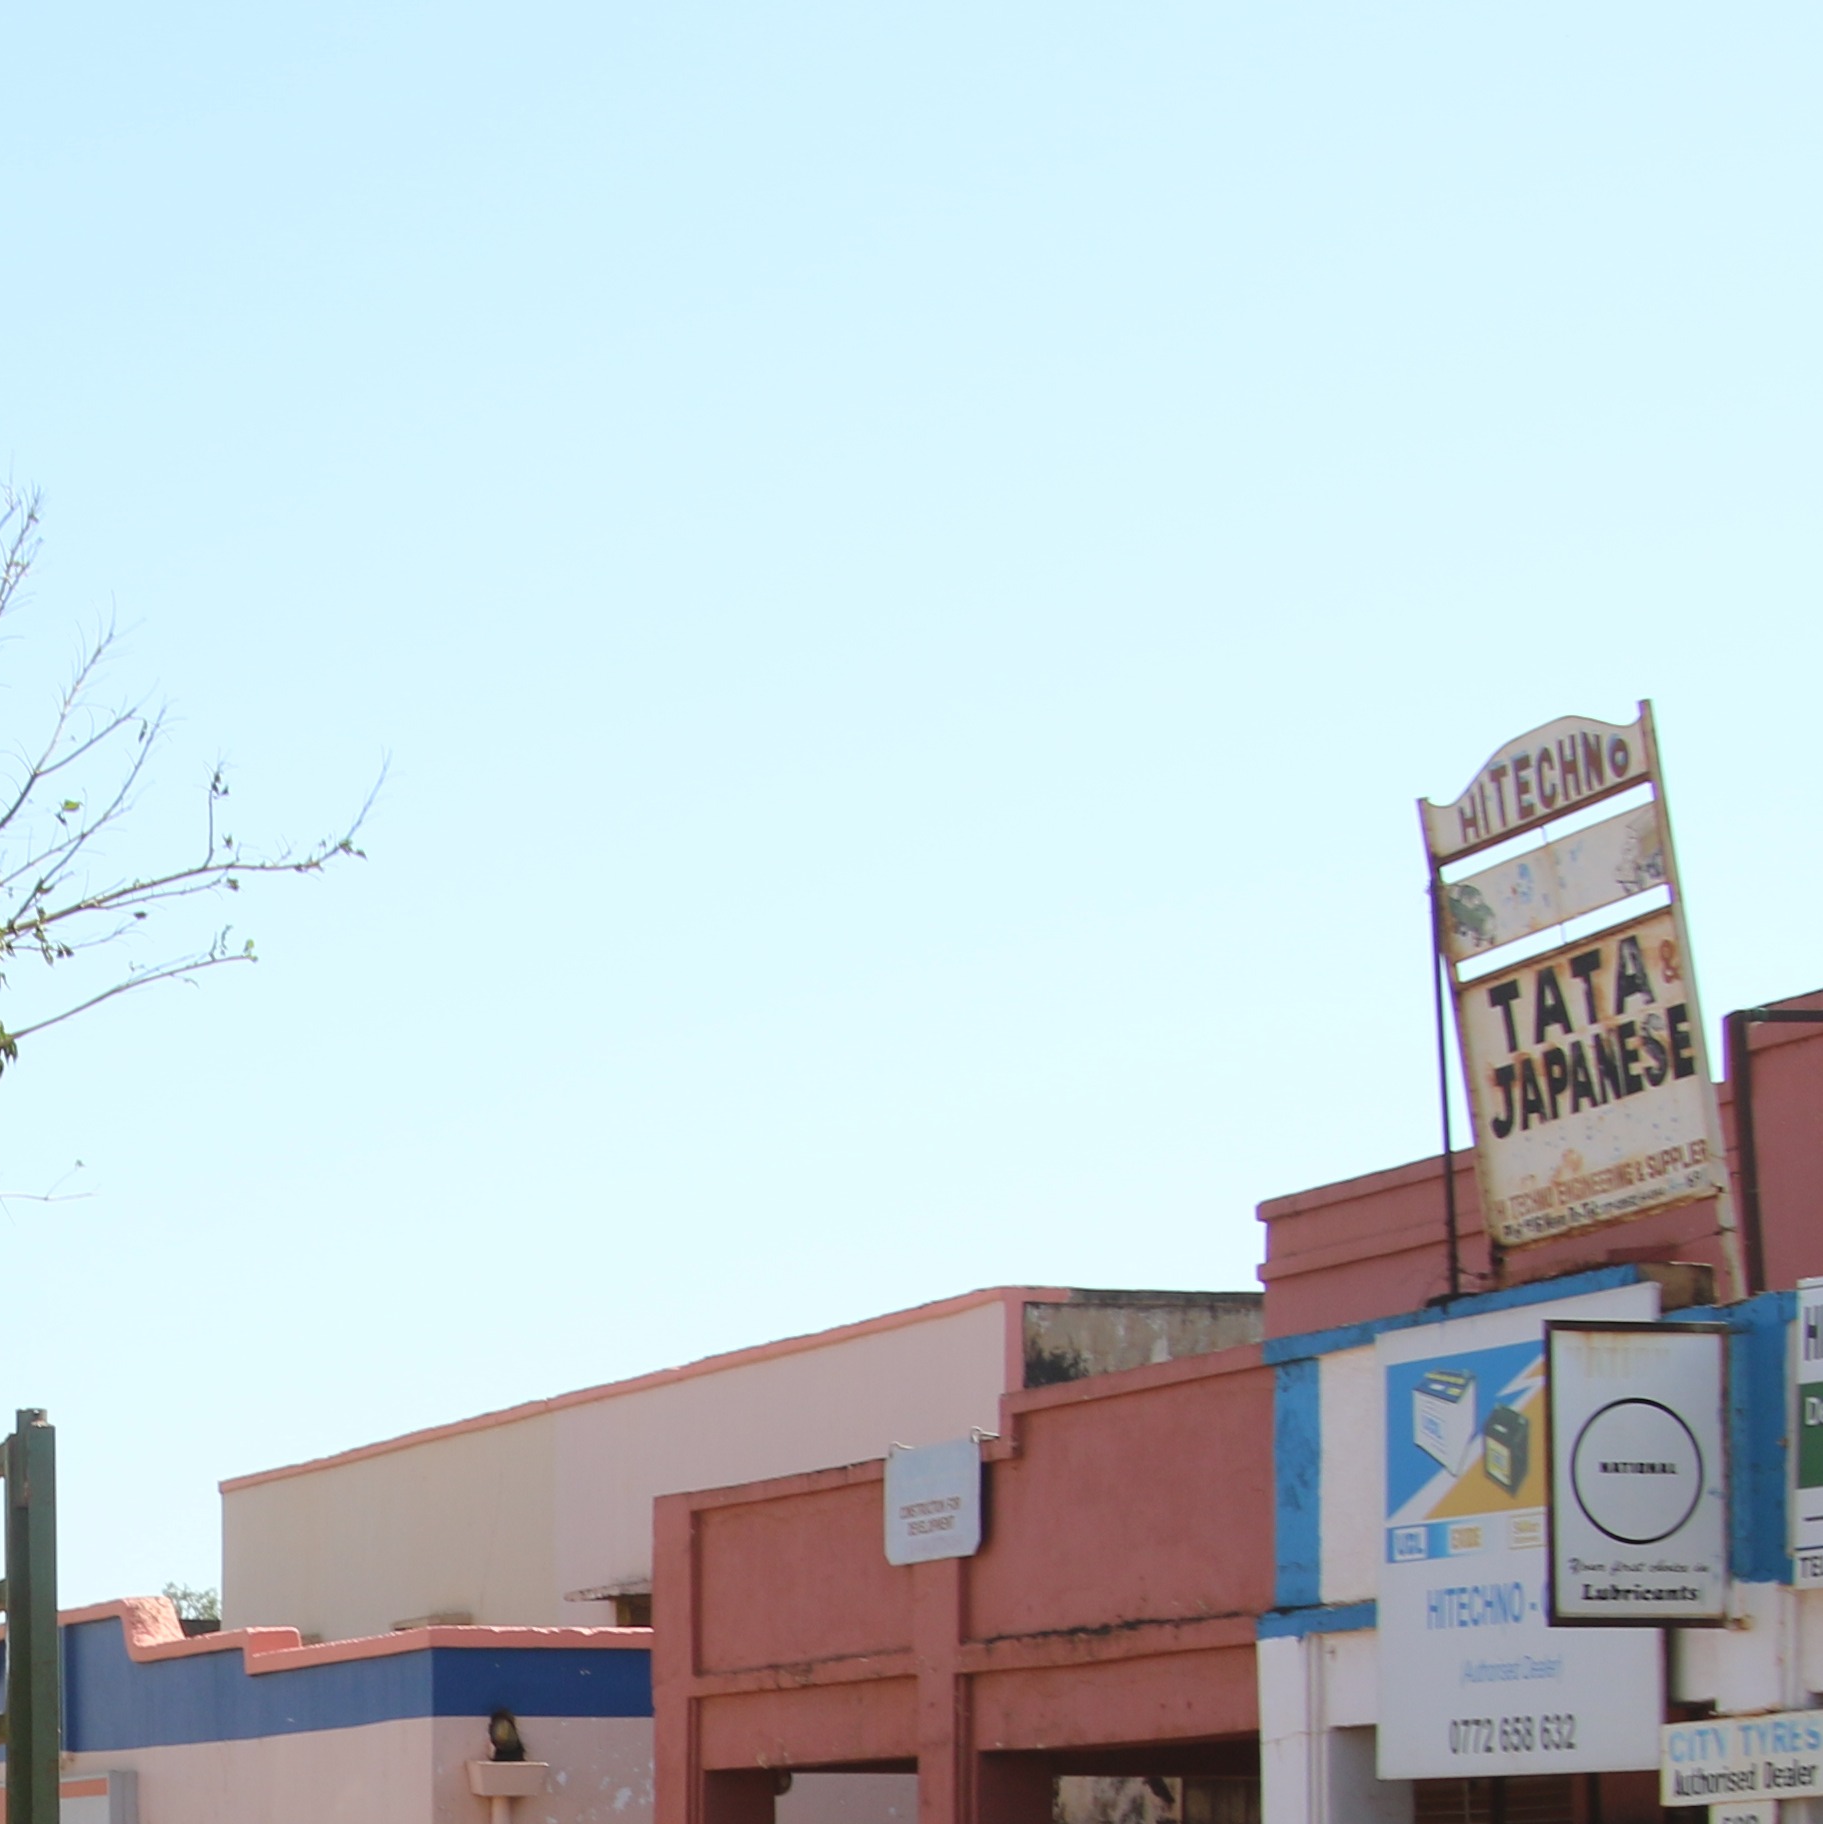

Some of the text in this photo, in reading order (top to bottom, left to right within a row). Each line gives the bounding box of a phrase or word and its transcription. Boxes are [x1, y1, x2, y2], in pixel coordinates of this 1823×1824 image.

[1459, 732, 1630, 844] HITECHNO
[1488, 935, 1656, 1053] TATA
[1491, 1002, 1697, 1139] JAPANESE
[1599, 1462, 1679, 1475] NATIONAL
[1427, 1582, 1523, 1631] HITECHNO
[1581, 1583, 1699, 1601] Lubricants
[1449, 1713, 1576, 1754] 0772 658 632
[1669, 1720, 1822, 1762] CITY TYRES
[1673, 1758, 1818, 1797] Authorised Dealer
